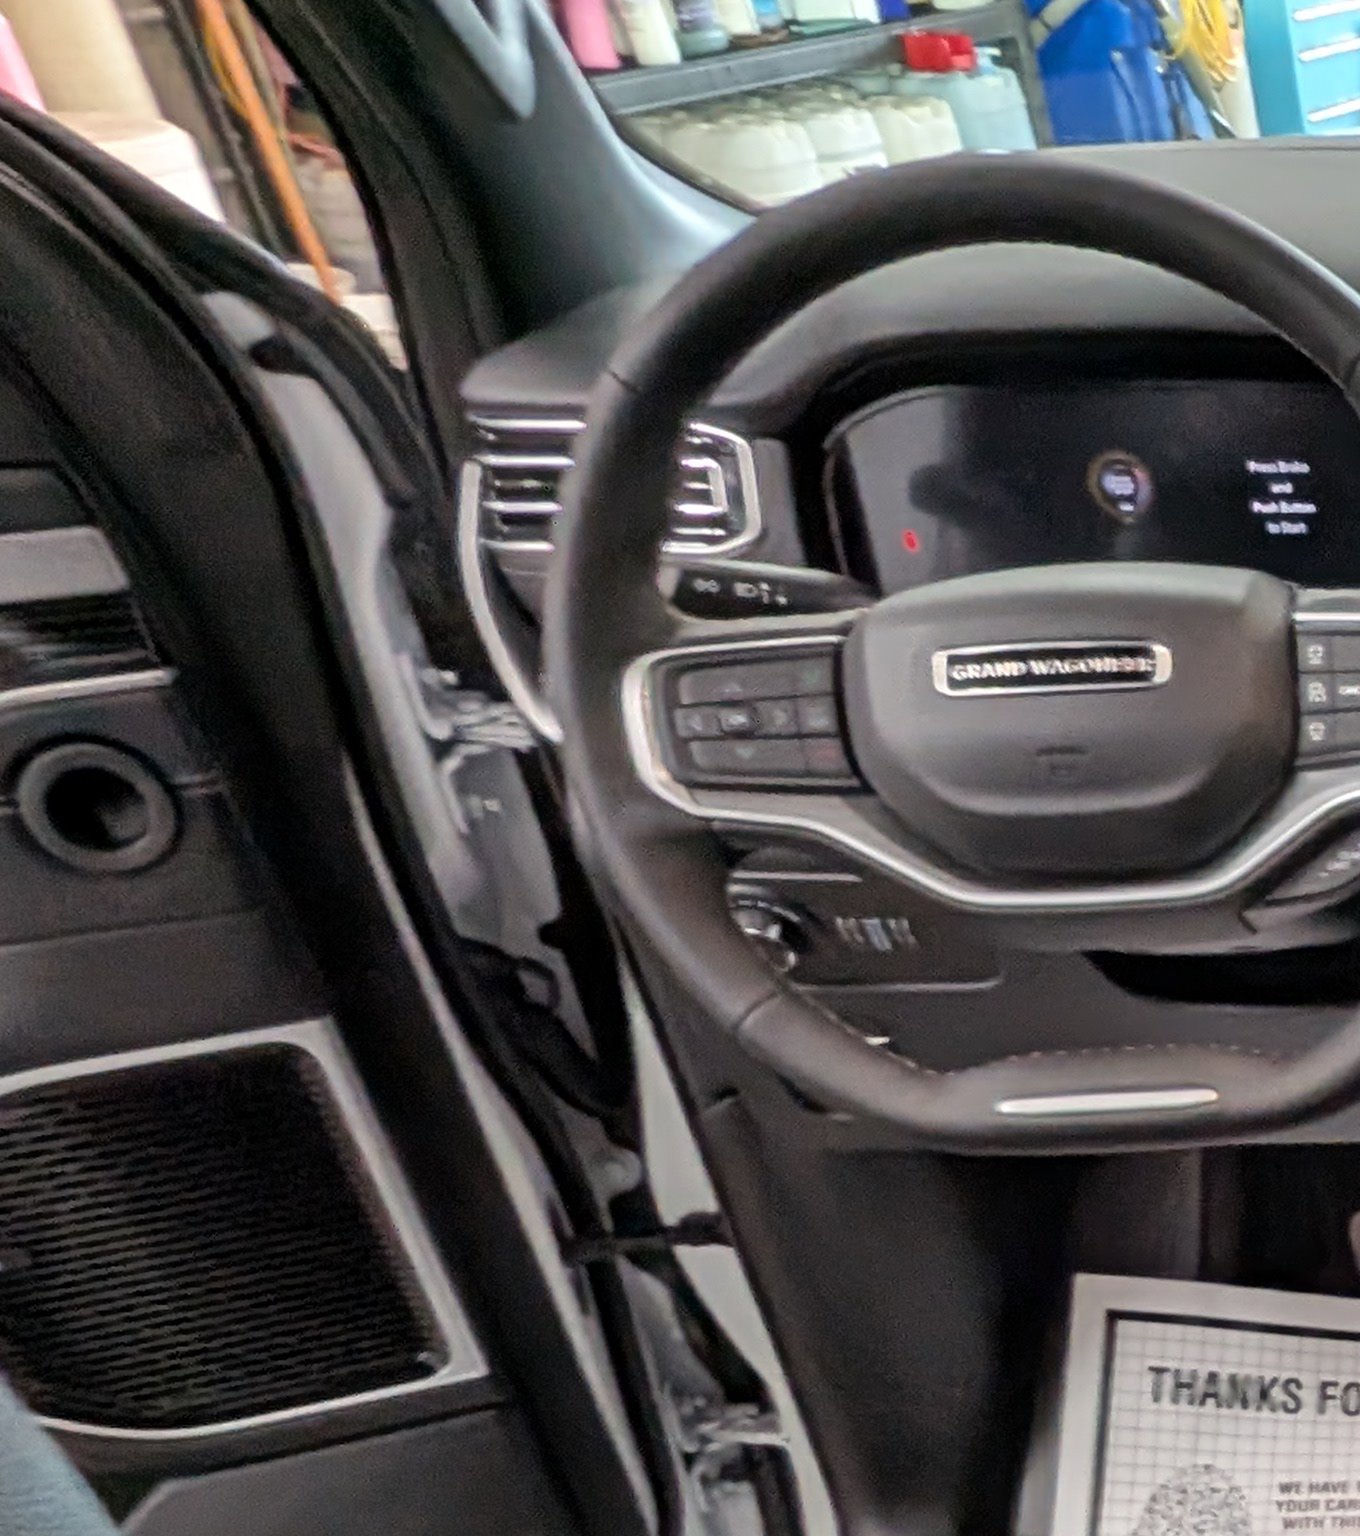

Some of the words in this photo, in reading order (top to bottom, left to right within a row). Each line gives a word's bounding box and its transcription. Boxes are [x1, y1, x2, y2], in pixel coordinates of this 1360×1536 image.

[951, 660, 1028, 681] GRAND
[1147, 1365, 1303, 1415] THANKS
[1308, 1480, 1349, 1494] HAVE
[1275, 1499, 1320, 1512] YOUR
[1282, 1516, 1325, 1530] WITH
